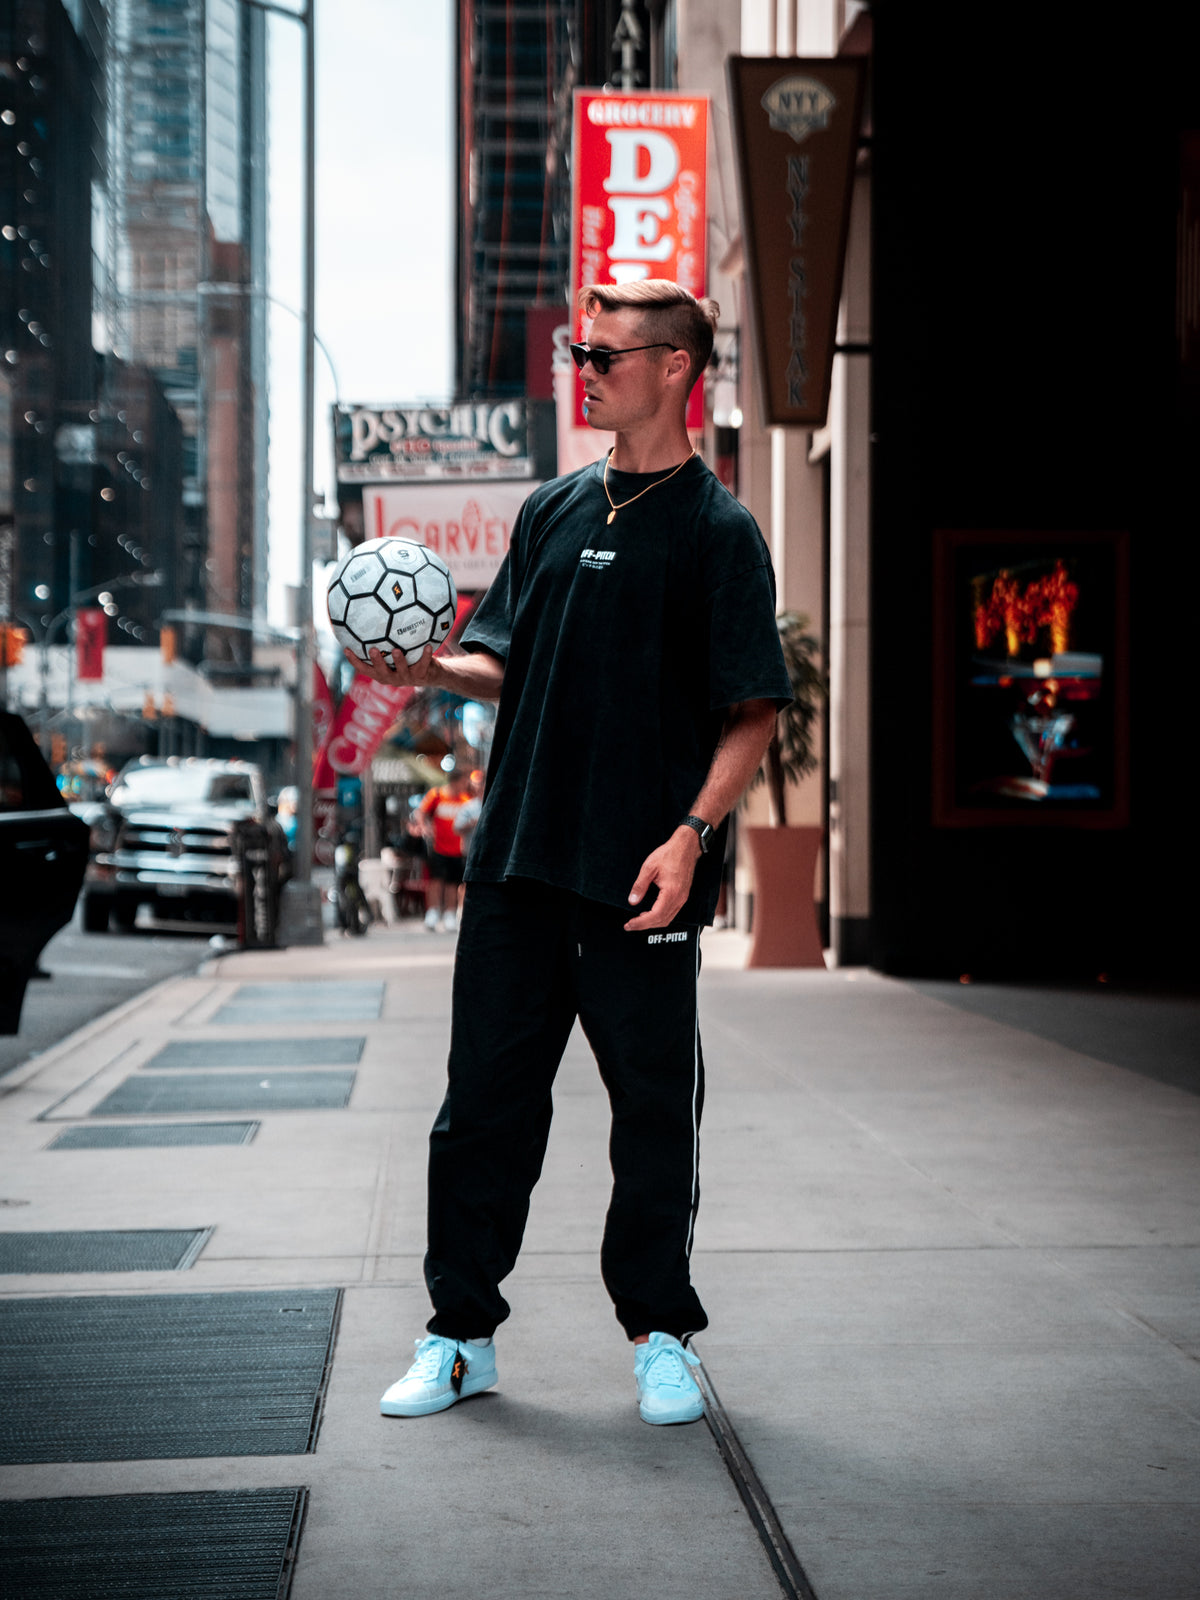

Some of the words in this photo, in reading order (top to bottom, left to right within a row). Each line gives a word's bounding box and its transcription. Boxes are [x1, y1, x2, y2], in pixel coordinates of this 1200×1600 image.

[587, 101, 696, 128] GROCERY
[779, 92, 818, 109] NYY
[786, 155, 809, 247] NYY
[785, 257, 808, 408] STEAK
[350, 402, 521, 461] PSYCHIC
[647, 931, 688, 944] OFF-PITCH
